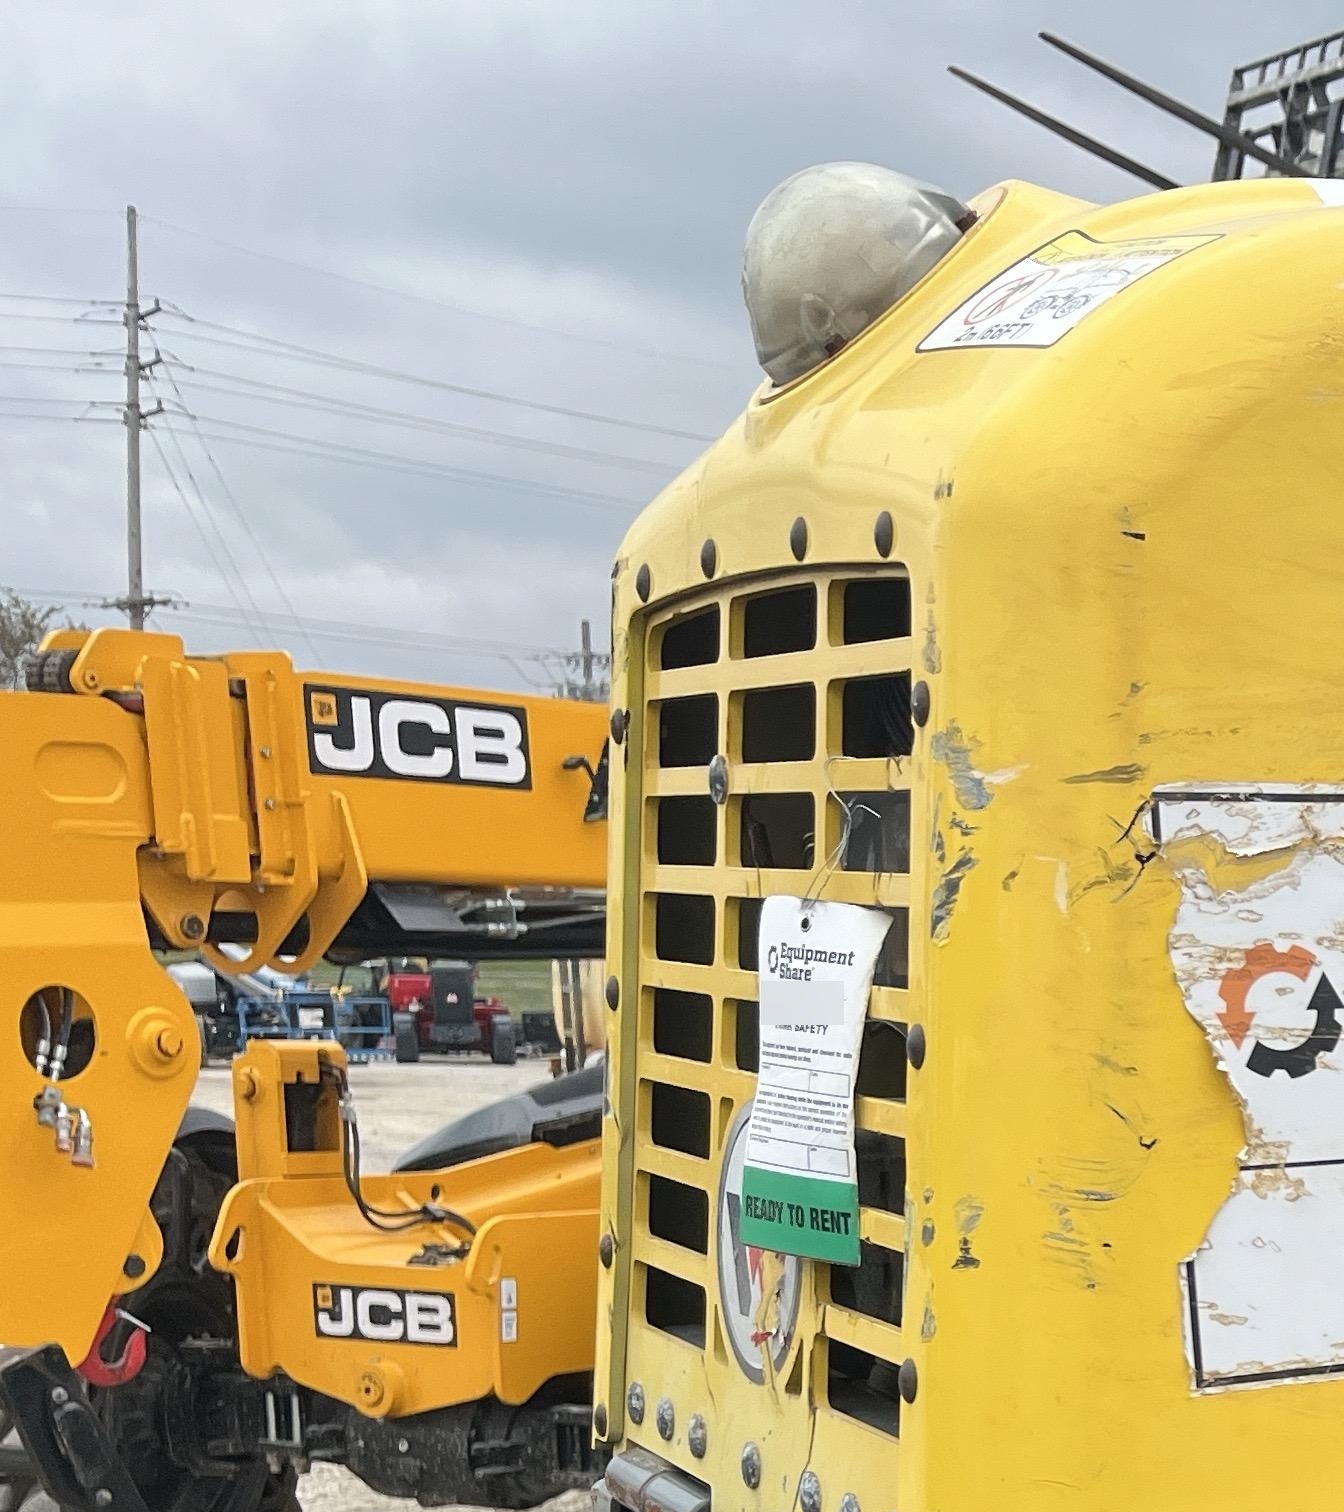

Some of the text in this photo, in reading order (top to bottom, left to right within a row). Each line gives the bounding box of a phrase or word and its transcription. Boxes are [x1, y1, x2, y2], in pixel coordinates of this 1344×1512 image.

[314, 696, 527, 784] JCB
[779, 963, 812, 981] Share
[781, 942, 856, 967] Equipment
[746, 1194, 852, 1236] READY TO RENT
[318, 1288, 454, 1344] JCB
